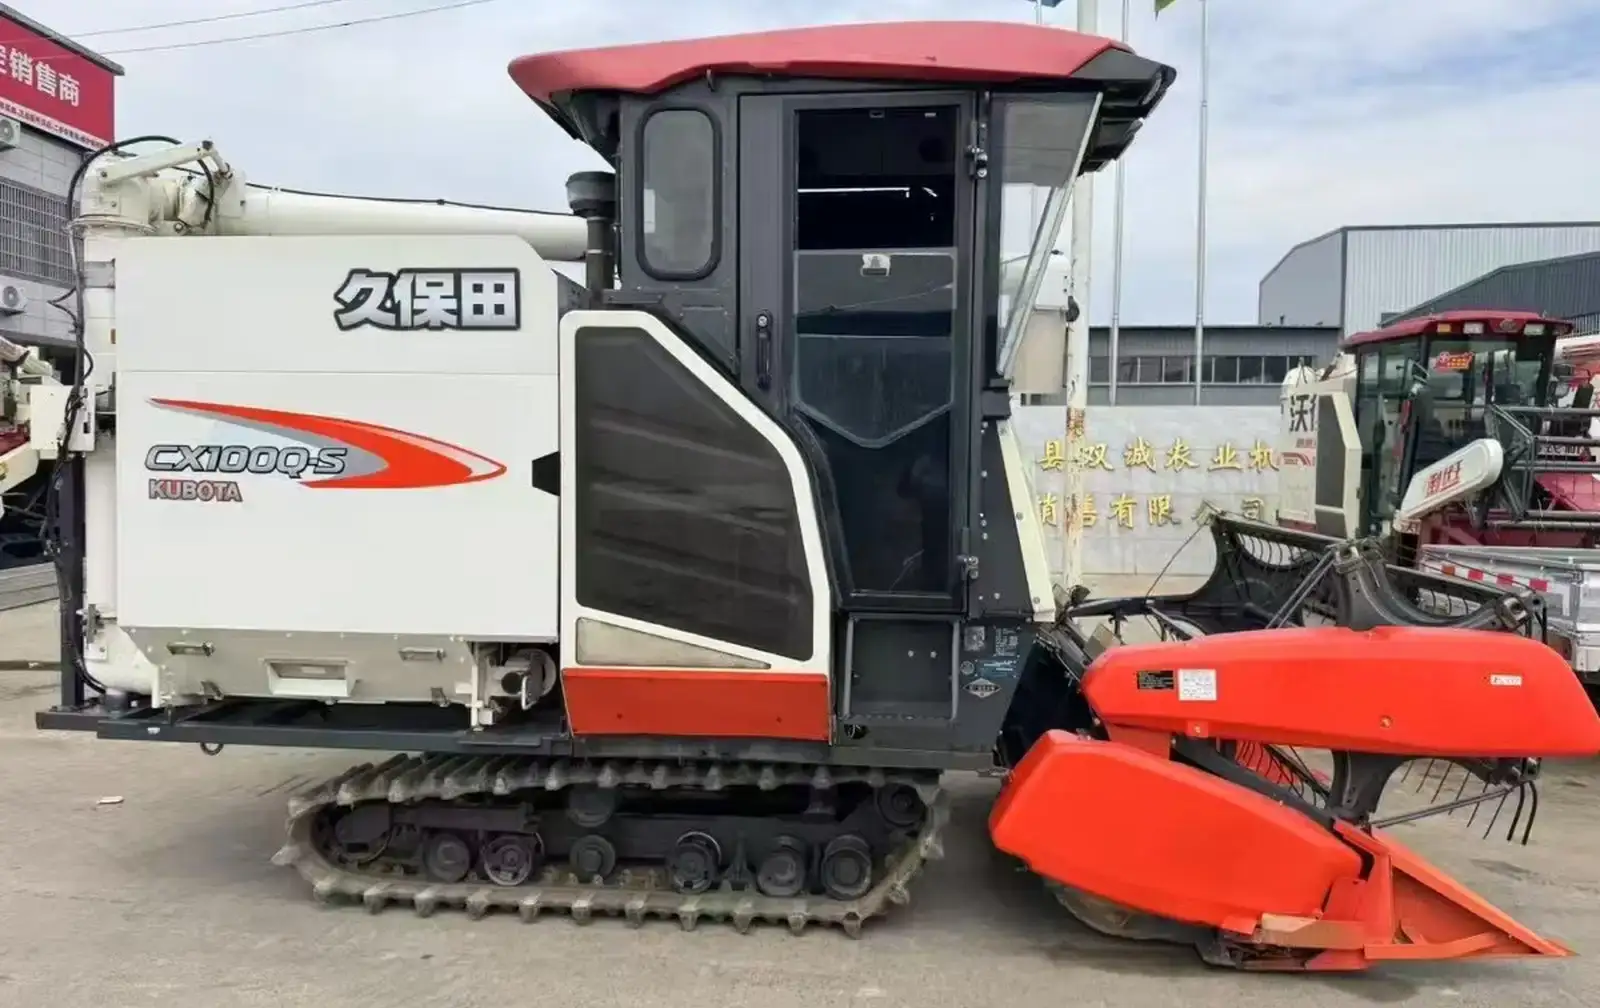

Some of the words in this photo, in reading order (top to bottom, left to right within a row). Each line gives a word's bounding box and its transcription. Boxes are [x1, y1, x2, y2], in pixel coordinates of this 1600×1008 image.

[334, 268, 521, 331] 久保田
[145, 444, 348, 478] CX100Q-S
[148, 479, 244, 502] KUBOTA
